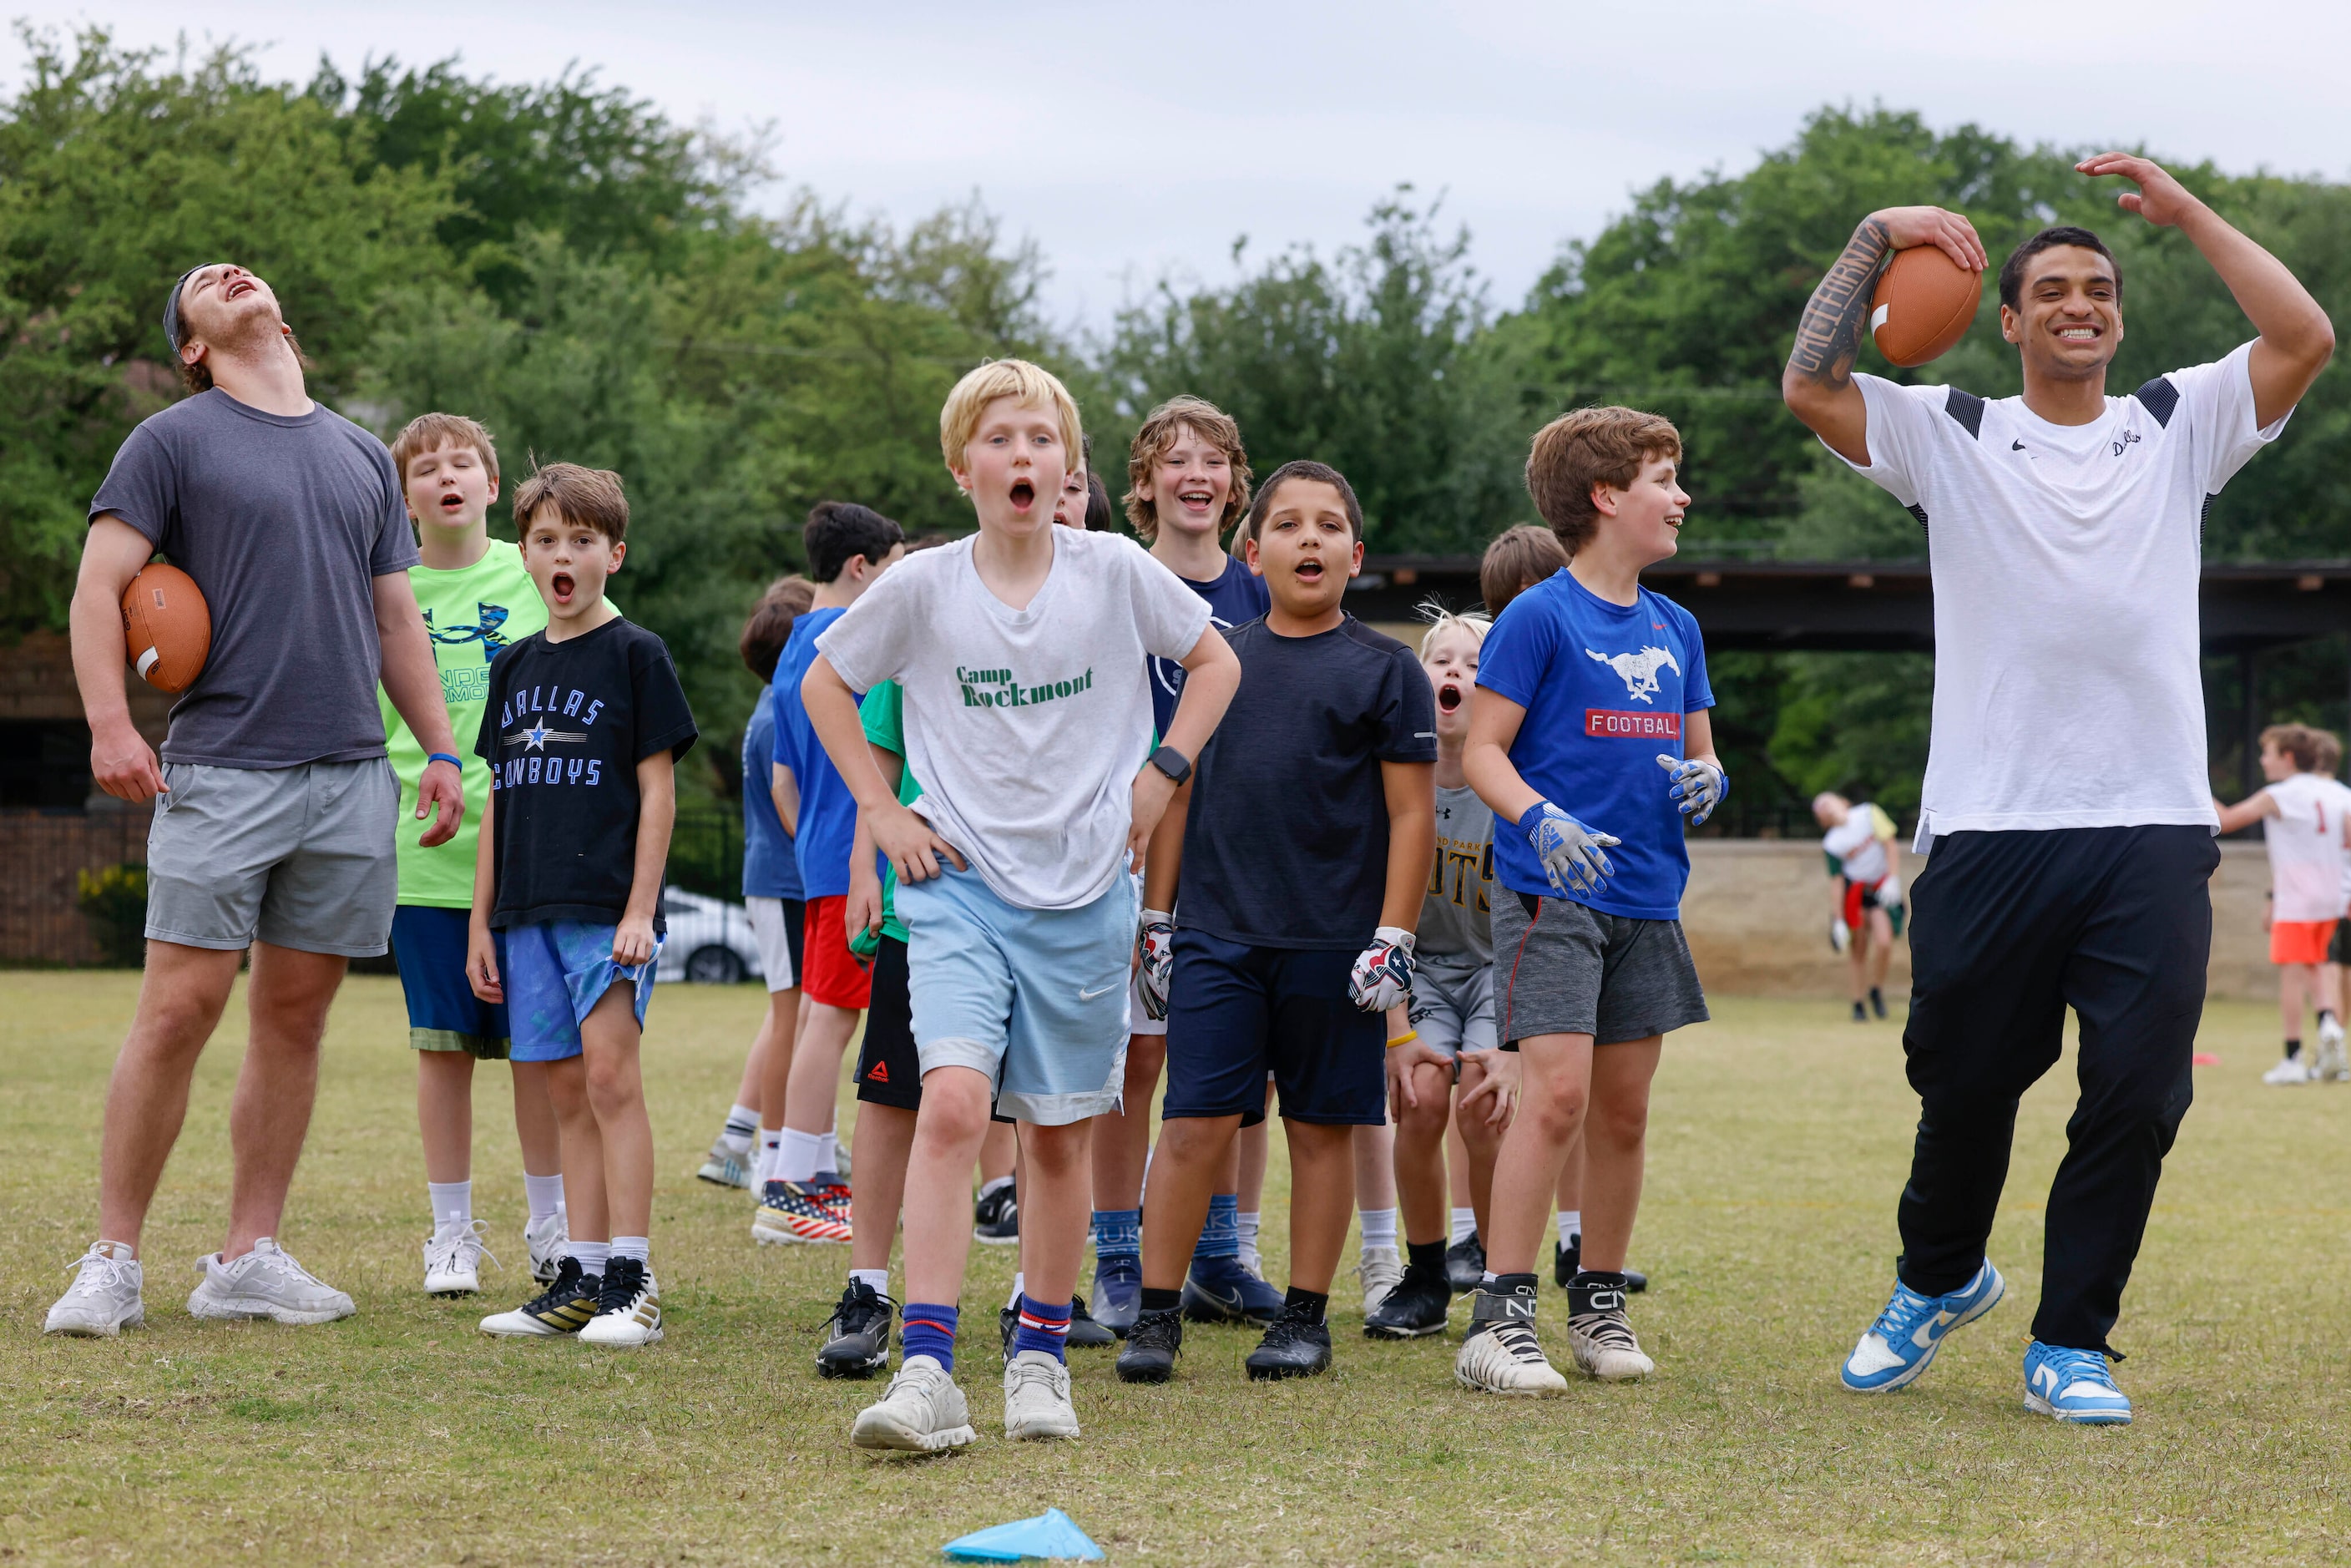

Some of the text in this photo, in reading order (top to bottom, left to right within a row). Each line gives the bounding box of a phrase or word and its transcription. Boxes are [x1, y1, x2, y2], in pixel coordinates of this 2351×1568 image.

[1789, 221, 1890, 372] CALIFORNIA
[2112, 429, 2141, 457] Dllas
[438, 666, 490, 687] NDE
[956, 665, 1012, 686] Camp
[960, 665, 1093, 708] Rockmont
[501, 685, 604, 729] DALLAS
[1591, 715, 1676, 735] FOOTBAL
[493, 756, 602, 791] COWBOYS
[2313, 799, 2329, 834] 1
[1453, 840, 1482, 851] PARK
[1542, 823, 1550, 861] adidas
